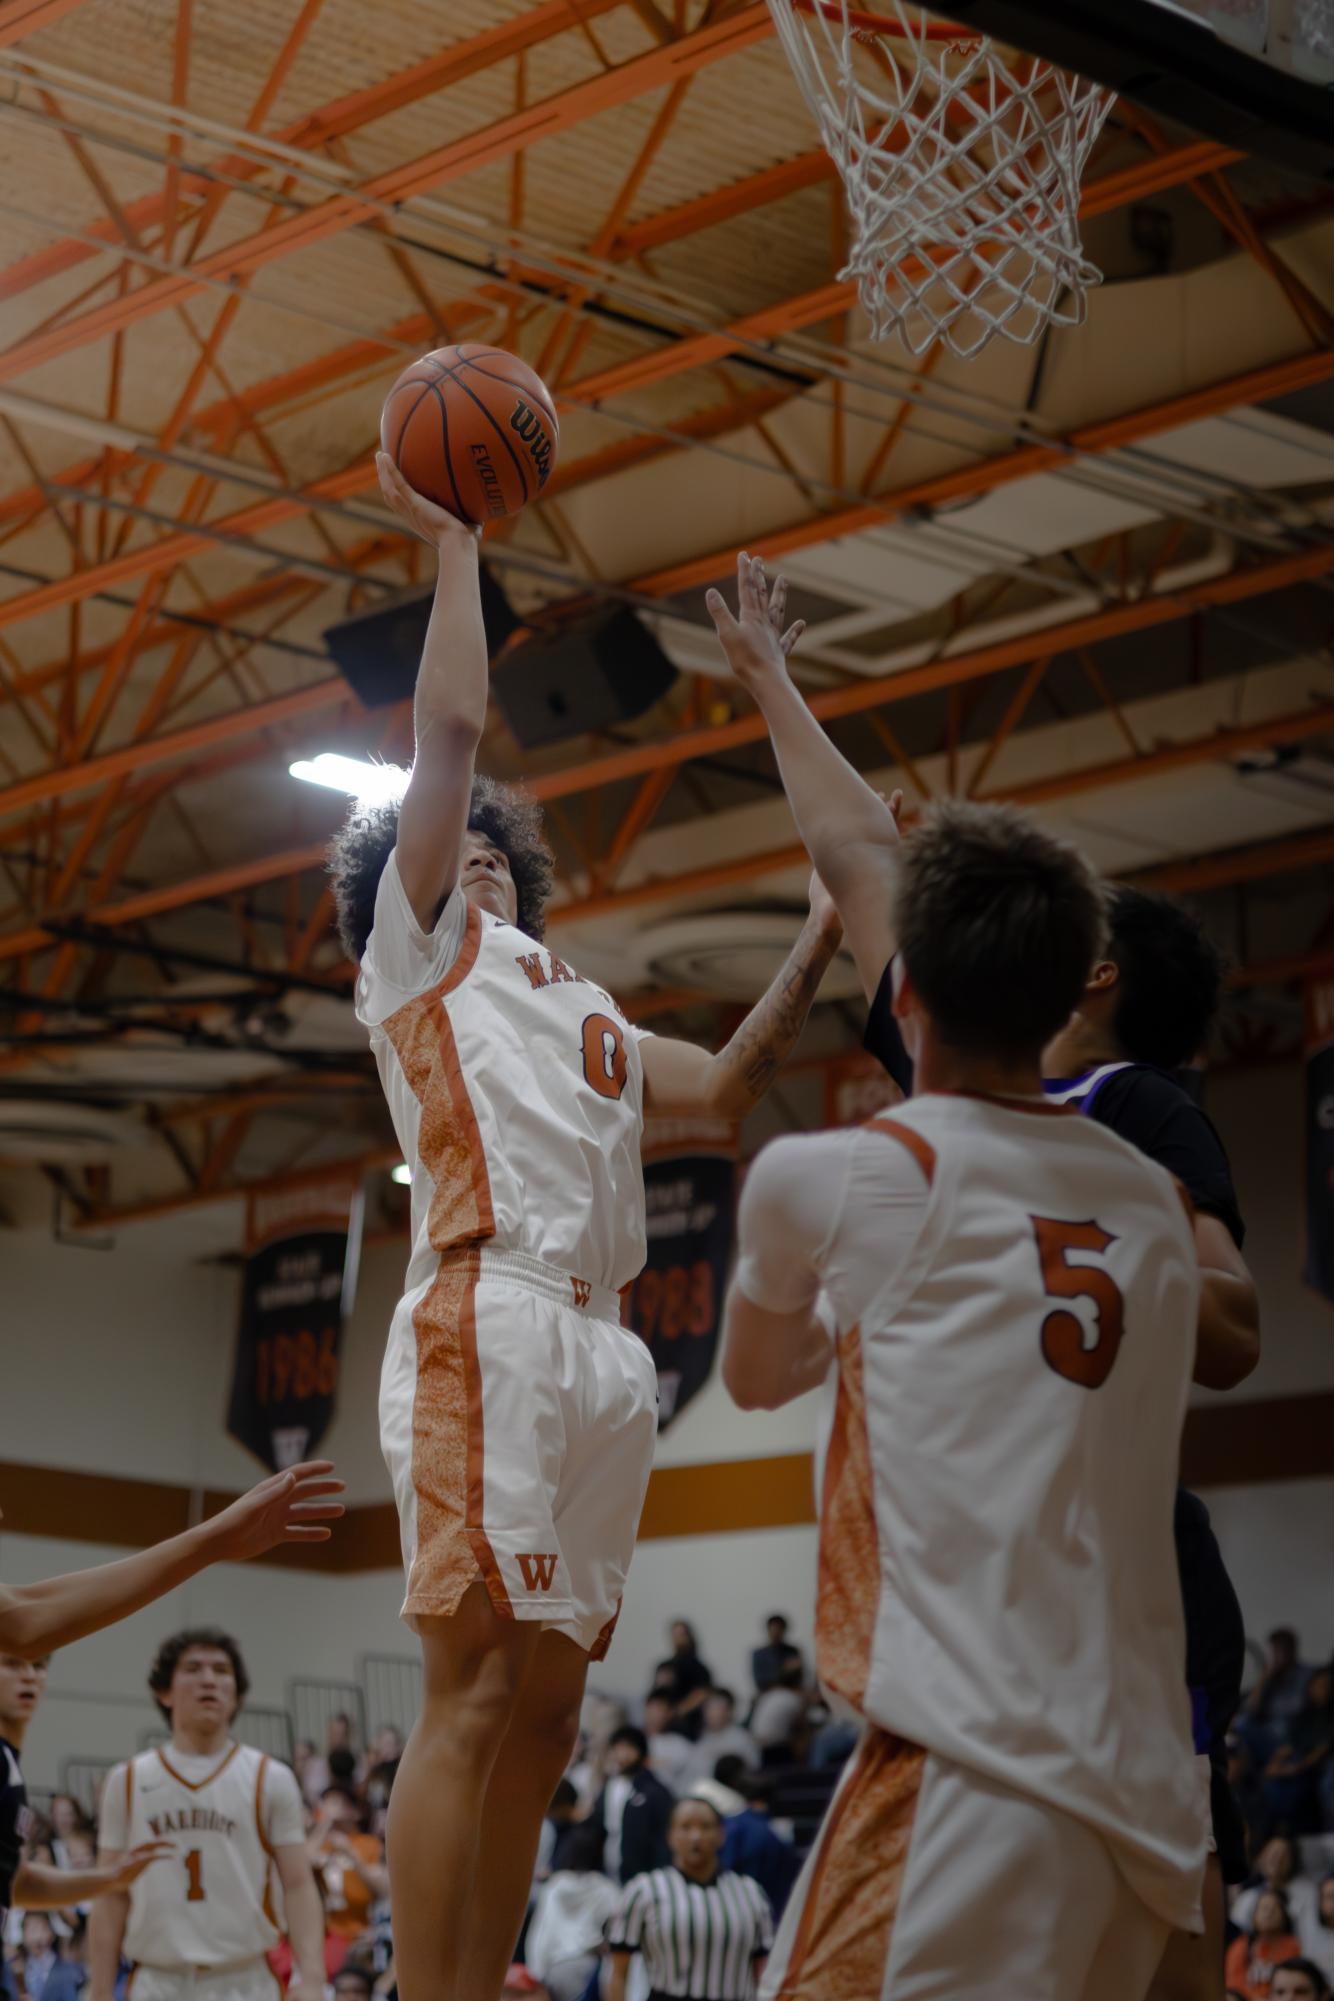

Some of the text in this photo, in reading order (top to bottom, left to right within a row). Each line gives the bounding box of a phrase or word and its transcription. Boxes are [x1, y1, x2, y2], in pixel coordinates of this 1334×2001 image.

[579, 1012, 628, 1100] 0
[569, 1275, 592, 1308] W
[1027, 1214, 1125, 1389] 5
[515, 1553, 558, 1591] W
[185, 1850, 204, 1901] 1
